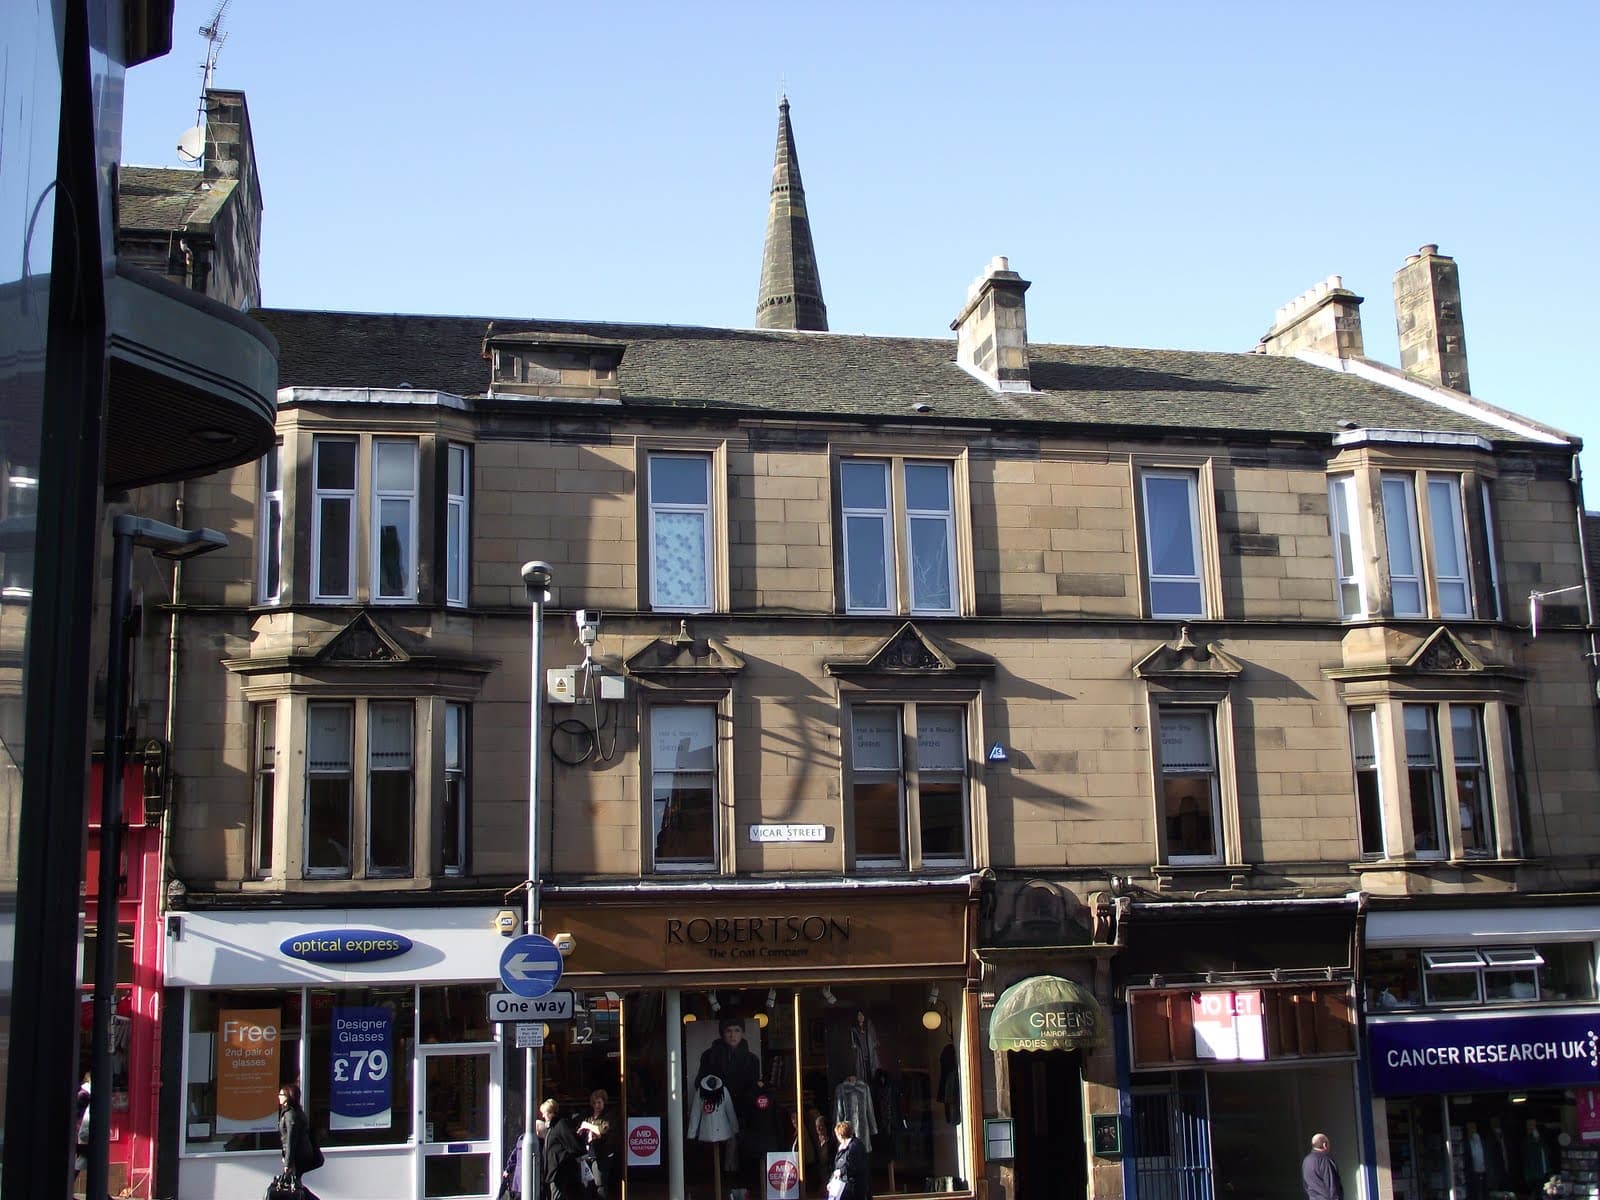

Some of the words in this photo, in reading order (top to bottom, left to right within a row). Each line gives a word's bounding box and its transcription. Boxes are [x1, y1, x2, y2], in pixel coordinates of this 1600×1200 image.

[752, 828, 783, 837] VICAR
[787, 828, 823, 837] STREET
[667, 915, 850, 945] ROBERTSON
[292, 937, 342, 955] optical
[345, 939, 400, 954] express
[708, 948, 727, 959] The
[730, 948, 755, 958] Coat
[496, 999, 529, 1013] One
[534, 1000, 566, 1013] way
[1199, 995, 1221, 1015] TO
[336, 1019, 388, 1031] Designer
[1029, 1010, 1095, 1028] GREENS
[223, 1021, 278, 1043] Free
[338, 1031, 385, 1042] Glasses
[1013, 1039, 1048, 1048] LADIES
[1052, 1039, 1060, 1048] &
[225, 1048, 243, 1057] 2nd
[244, 1047, 262, 1058] pair
[264, 1046, 274, 1056] of
[1387, 1046, 1461, 1068] CANCER
[1463, 1041, 1558, 1065] RESEARCH
[1560, 1040, 1588, 1060] UK
[231, 1058, 267, 1069] glasses
[333, 1049, 389, 1082] £79
[636, 1130, 652, 1138] MID
[629, 1138, 659, 1146] SEASON
